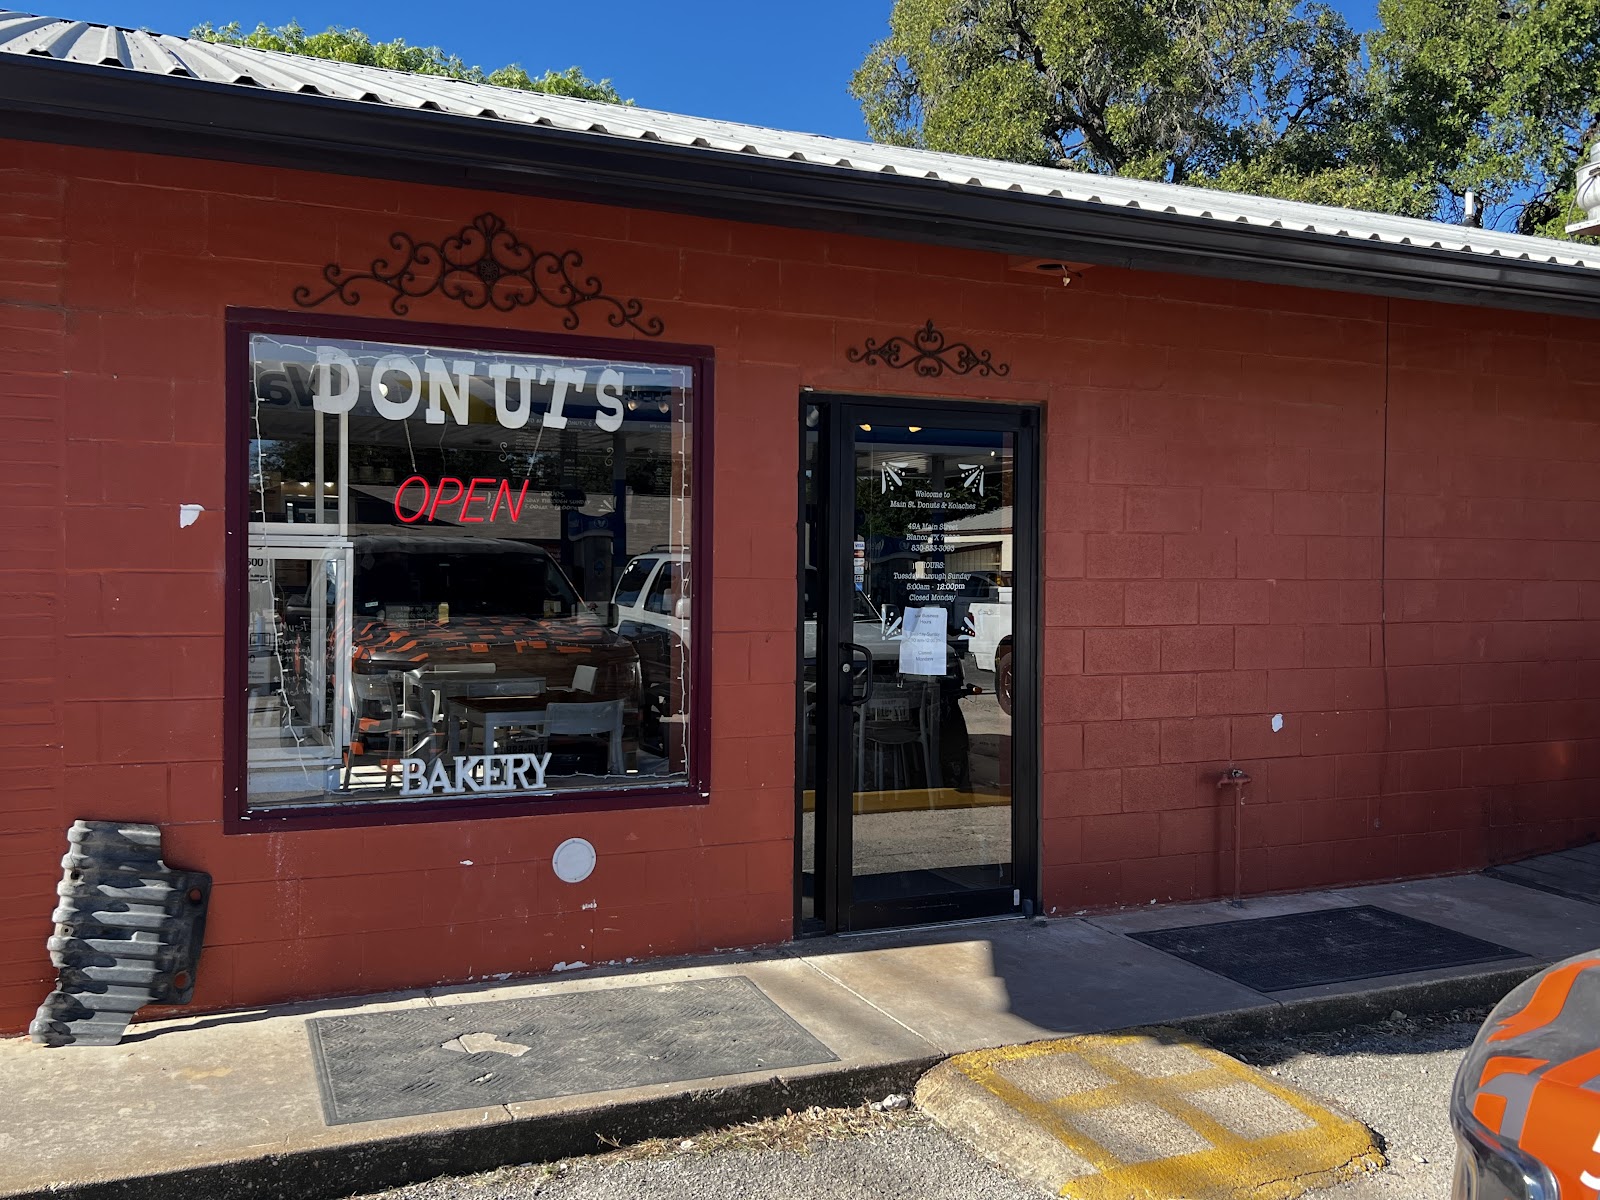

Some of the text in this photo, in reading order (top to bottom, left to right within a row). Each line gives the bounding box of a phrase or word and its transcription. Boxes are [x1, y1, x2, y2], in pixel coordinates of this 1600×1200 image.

[313, 346, 624, 432] DONUTS
[915, 490, 943, 498] Welcome
[394, 475, 530, 524] OPEN
[890, 500, 907, 508] Main
[948, 502, 976, 510] Kolaches
[893, 572, 972, 581] Tuesday hrough Sunday
[931, 594, 956, 602] Monday
[280, 621, 307, 632] Must
[400, 753, 552, 795] BAKERY
